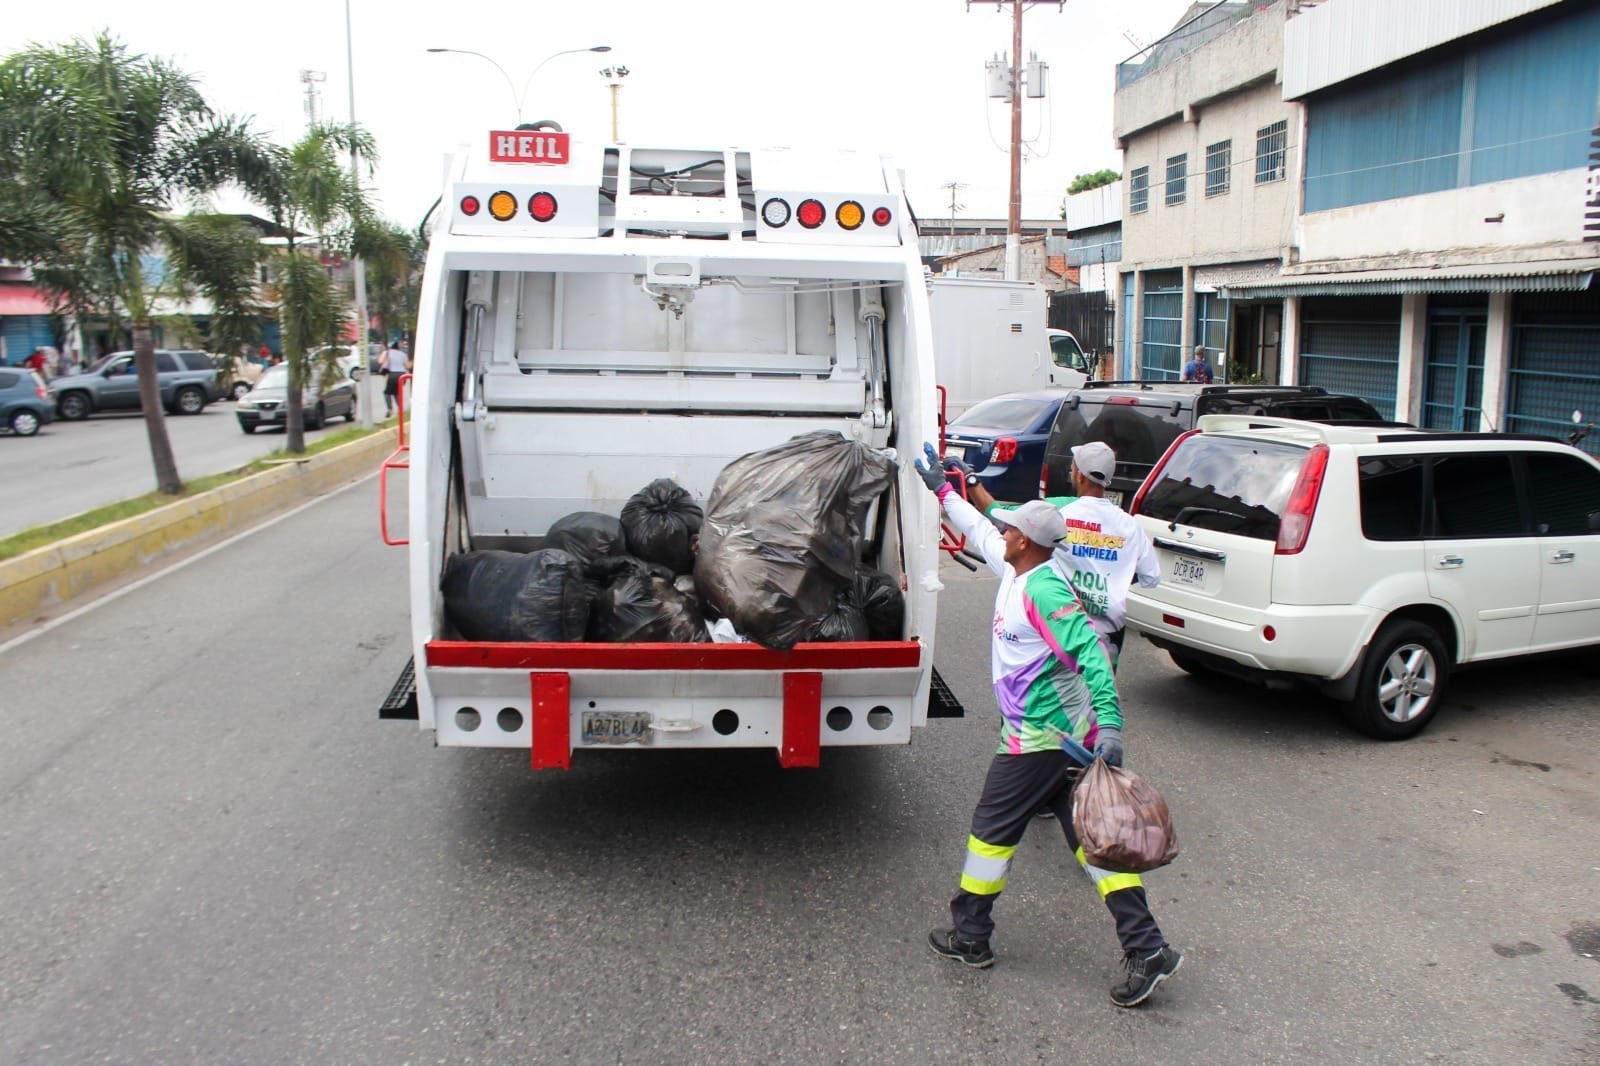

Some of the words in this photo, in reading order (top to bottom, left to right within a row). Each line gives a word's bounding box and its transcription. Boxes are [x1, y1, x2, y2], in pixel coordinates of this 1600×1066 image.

[497, 135, 563, 159] HEIL
[1072, 545, 1118, 562] LIMPIEZA
[1071, 569, 1110, 593] AQUÍ
[1097, 594, 1108, 605] SE
